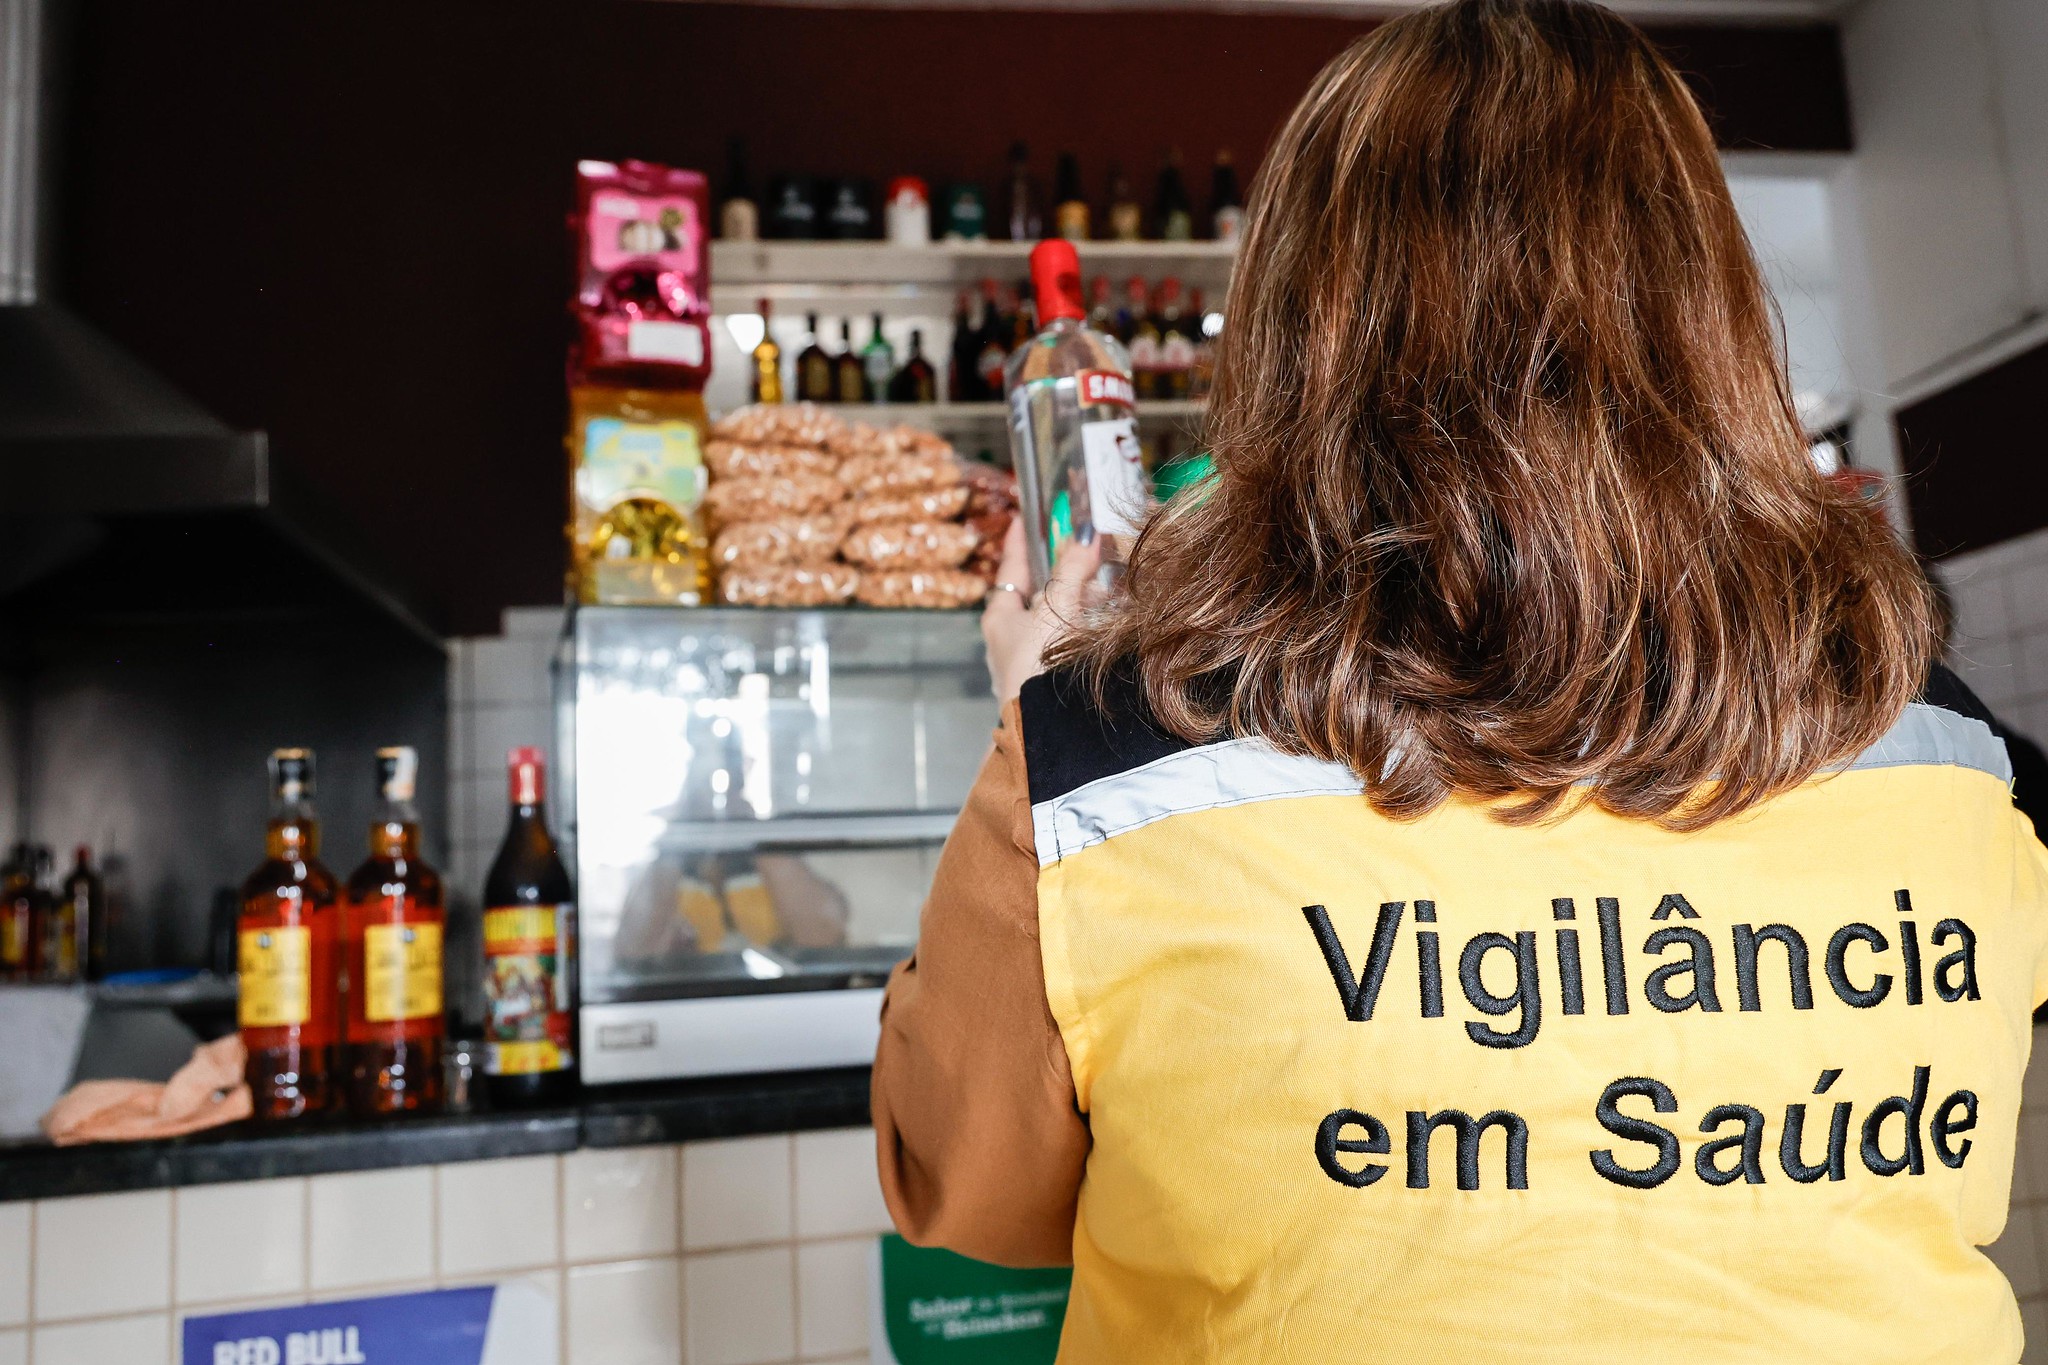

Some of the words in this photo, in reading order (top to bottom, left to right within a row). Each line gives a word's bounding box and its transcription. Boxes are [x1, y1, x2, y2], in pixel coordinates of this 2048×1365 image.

[1302, 889, 1982, 1050] Vigilância
[1314, 1108, 1530, 1191] em
[1589, 1064, 1979, 1190] Saúde
[213, 1336, 281, 1365] RED
[285, 1325, 366, 1365] BULL
